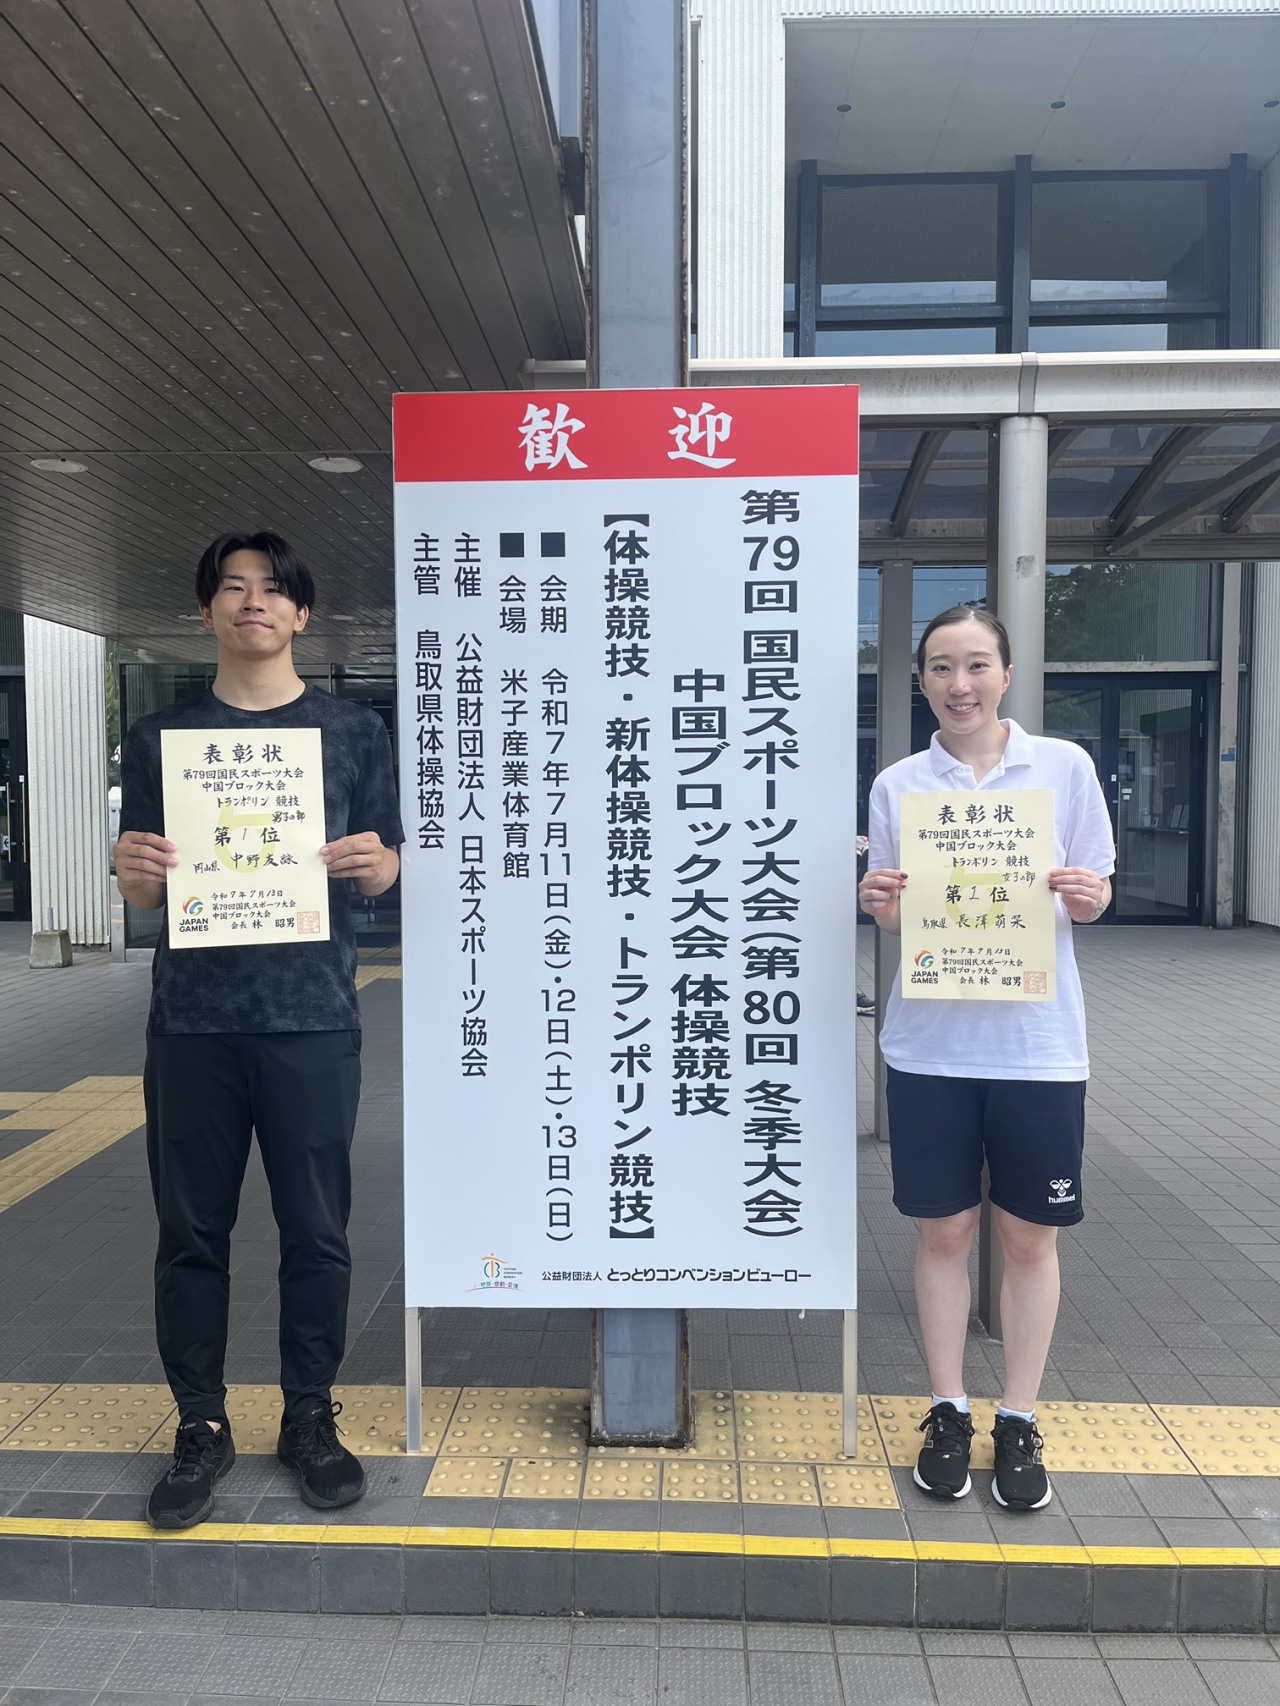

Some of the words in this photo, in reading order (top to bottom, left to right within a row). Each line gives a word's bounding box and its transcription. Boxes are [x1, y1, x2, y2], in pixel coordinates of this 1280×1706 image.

[414, 532, 440, 595] 主管
[454, 532, 481, 597] 主催
[499, 575, 526, 633] 会場
[540, 575, 567, 633] 会期
[415, 629, 445, 849] 鳥取県体操協会
[202, 743, 284, 764] 表彰状
[183, 767, 305, 780] 第79回国民スポーツ大会
[501, 668, 529, 878] 米子産業体育館
[202, 781, 286, 792] 中国ブロック大会
[216, 797, 269, 808] トランポリン
[275, 795, 300, 807] 競技
[937, 804, 1015, 825] 表彰状
[918, 828, 1035, 840] 第79回国民スポーツ大会
[936, 840, 1017, 852] 中国ブロック大会
[952, 856, 999, 868] トランポリン
[1006, 855, 1030, 867] 競技
[212, 900, 296, 911] 第79回国民スポーツ大会
[212, 910, 271, 920] 中国ブロック大会
[179, 925, 209, 933] GAMES
[942, 958, 1023, 967] 第79回国民スポーツ大会
[942, 967, 998, 975] 中国ブロック大会
[670, 974, 732, 1116] 体操競技
[1048, 1193, 1076, 1204] hummel
[541, 1270, 603, 1283] 公益財団法人
[606, 1267, 812, 1283] とっとりコンベンションビューロー
